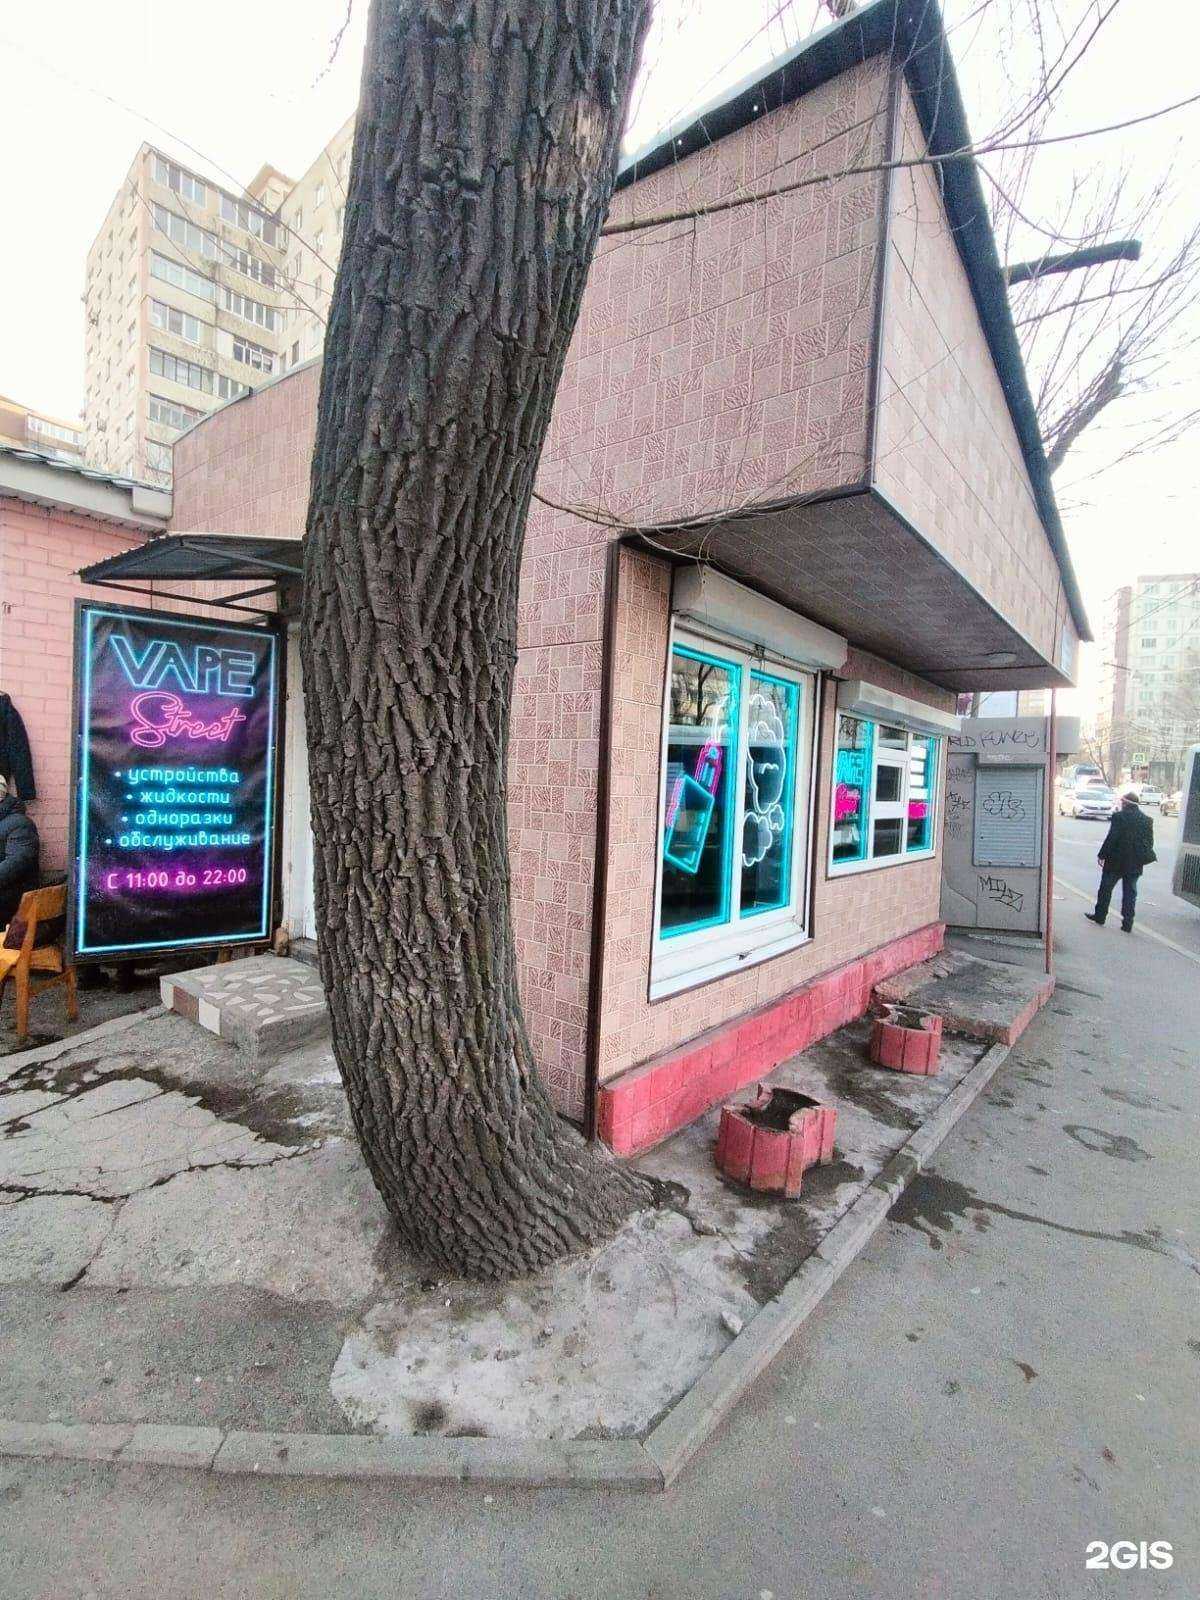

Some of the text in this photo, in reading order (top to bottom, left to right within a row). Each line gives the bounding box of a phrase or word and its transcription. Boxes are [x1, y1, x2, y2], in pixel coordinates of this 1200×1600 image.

[111, 634, 255, 696] VAPE
[131, 692, 246, 748] Street
[128, 767, 240, 785] устройства
[140, 788, 230, 803] жидкости
[135, 810, 233, 828] одноразки
[119, 831, 250, 850] обслуживание
[107, 868, 247, 889] С 11:00 до 22:00
